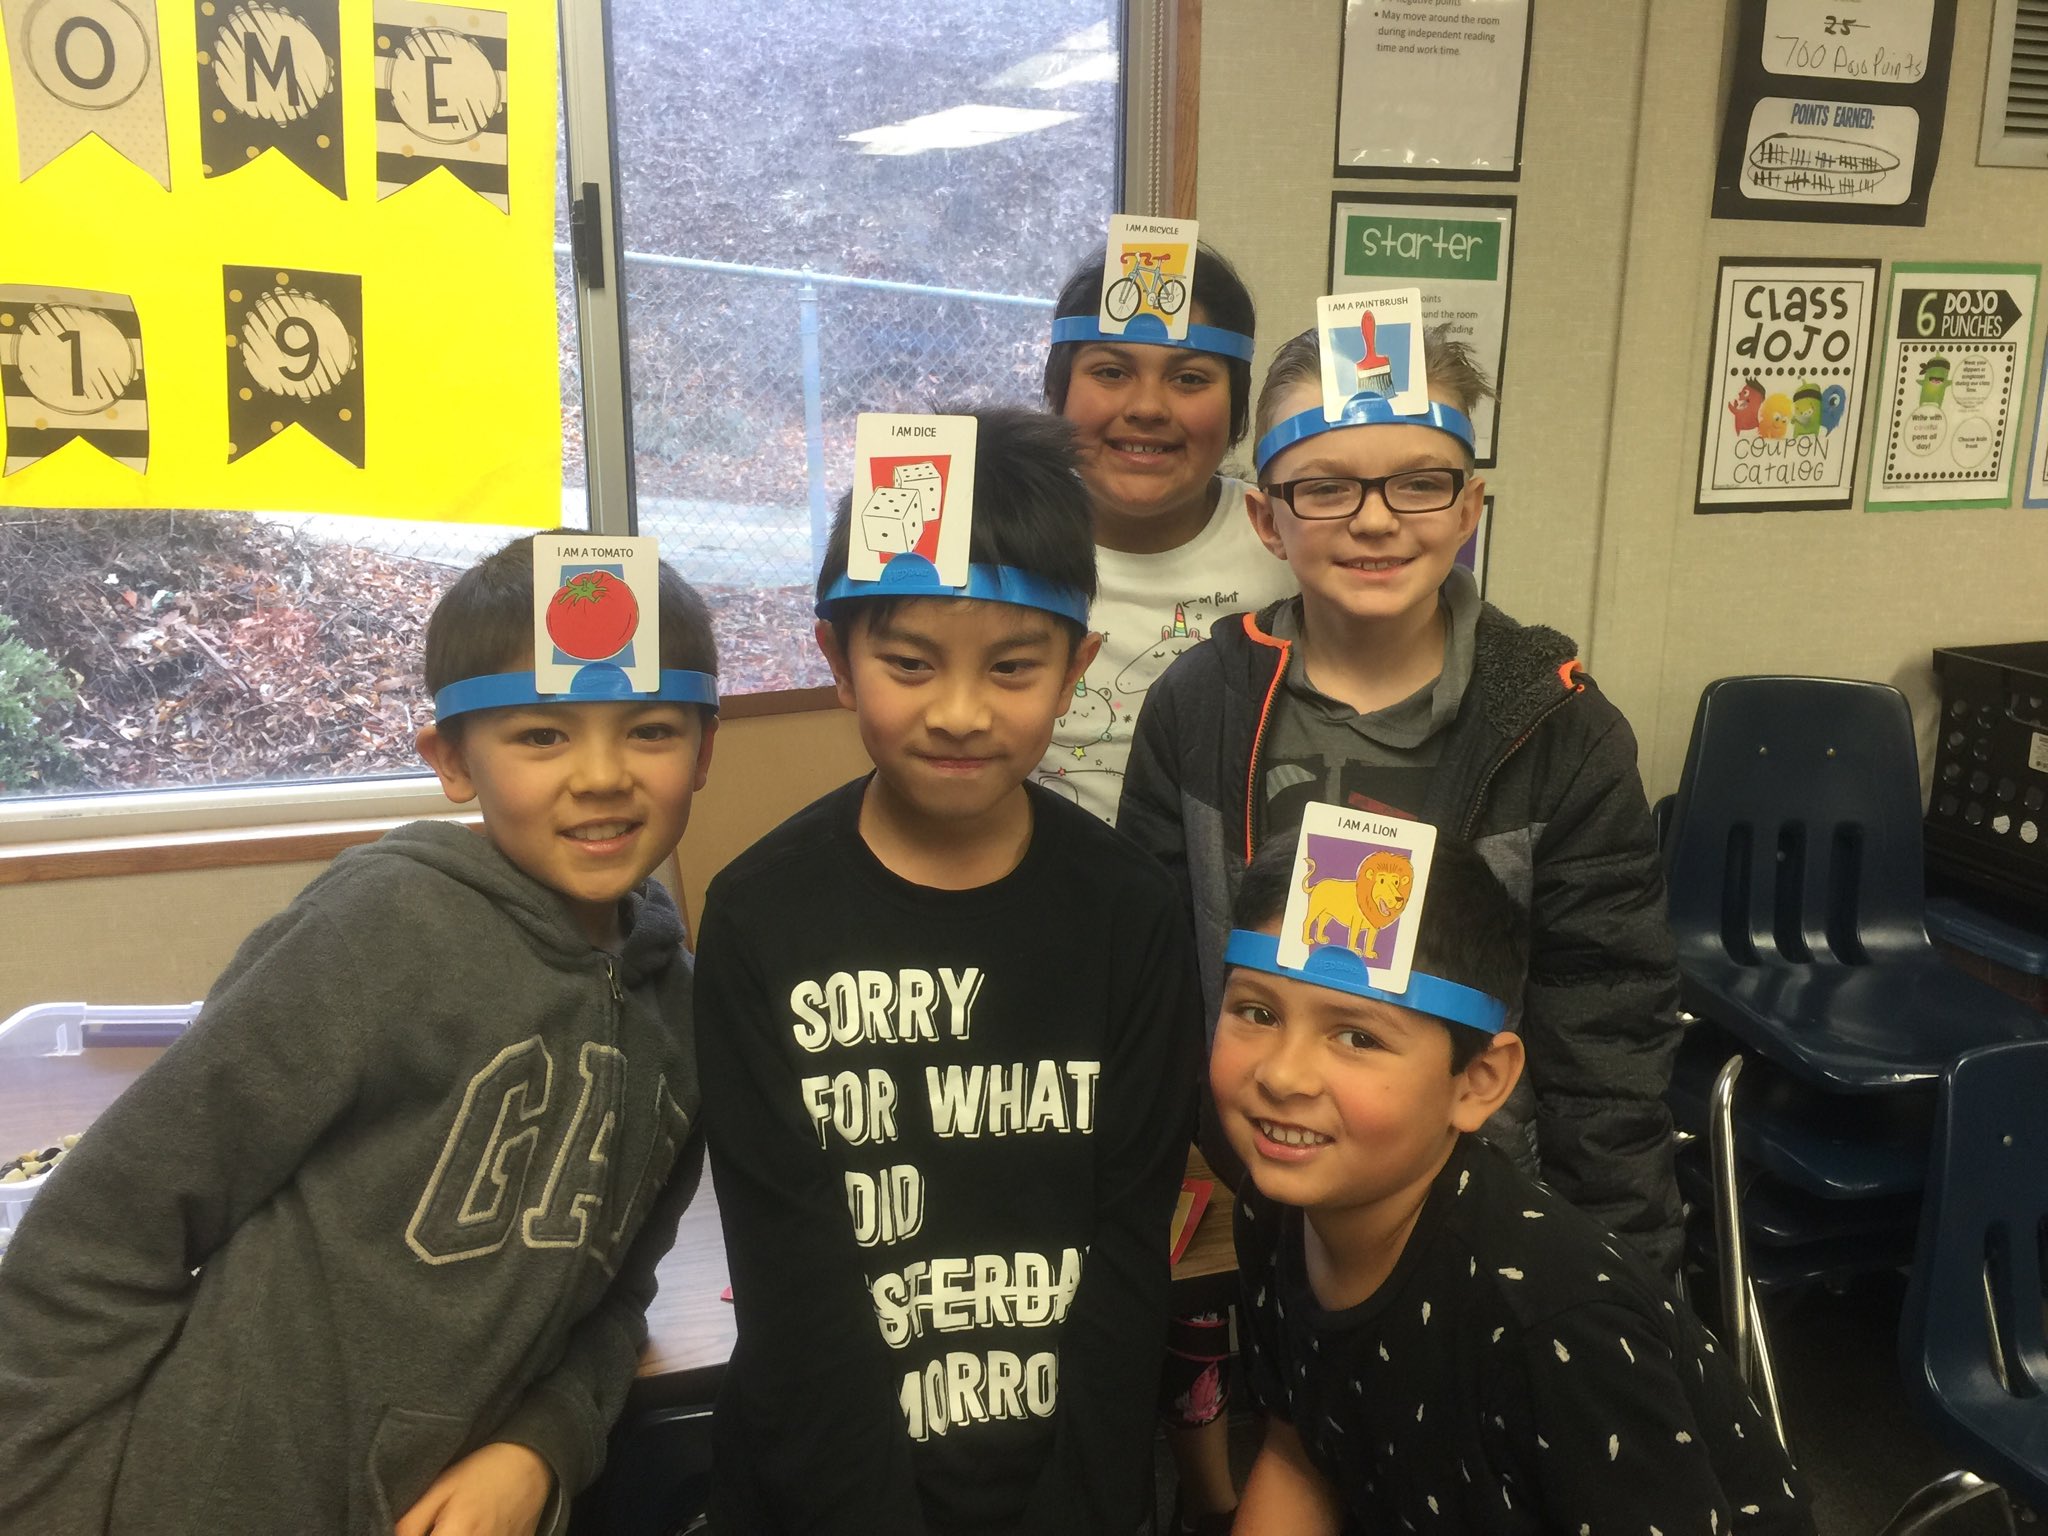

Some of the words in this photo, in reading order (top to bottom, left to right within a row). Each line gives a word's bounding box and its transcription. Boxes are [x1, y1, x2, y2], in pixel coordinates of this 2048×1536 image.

[1382, 10, 1401, 21] May
[1403, 12, 1427, 21] move
[1429, 14, 1459, 23] around
[1461, 15, 1475, 24] the
[1477, 17, 1500, 25] room
[1378, 27, 1406, 38] during
[1408, 28, 1462, 39] independent
[1464, 32, 1496, 43] reading
[1377, 43, 1397, 52] time
[1398, 44, 1415, 53] and
[1417, 45, 1438, 54] work
[1790, 103, 1830, 126] POINTS
[1833, 106, 1876, 129] EARNED:
[1129, 224, 1141, 232] AM
[1149, 226, 1179, 235] BICYCLE
[1362, 224, 1483, 261] starter
[1333, 303, 1346, 311] AM
[1347, 302, 1354, 310] A
[1355, 297, 1409, 309] PAINTBRUSH
[1421, 295, 1442, 303] oints
[1744, 285, 1848, 323] Class
[1421, 310, 1439, 319] und
[1441, 310, 1454, 319] the
[1916, 291, 1938, 338] 6
[1944, 290, 1999, 315] DOJO
[1445, 325, 1474, 335] eading
[1941, 315, 2002, 338] PUNCHES
[896, 427, 911, 436] AM
[914, 427, 937, 437] DICE
[1912, 434, 1928, 442] pens
[563, 547, 579, 558] AM
[581, 548, 589, 557] A
[591, 548, 634, 558] TOMATO
[1198, 595, 1212, 604] on
[1342, 818, 1360, 830] AM
[1362, 822, 1371, 833] A
[1372, 823, 1398, 838] LION
[790, 967, 985, 1052] SORRY
[801, 1068, 899, 1150] FOR
[925, 1059, 1101, 1139] WHAT
[844, 1164, 925, 1248] DID
[865, 1246, 1083, 1349] STERDA
